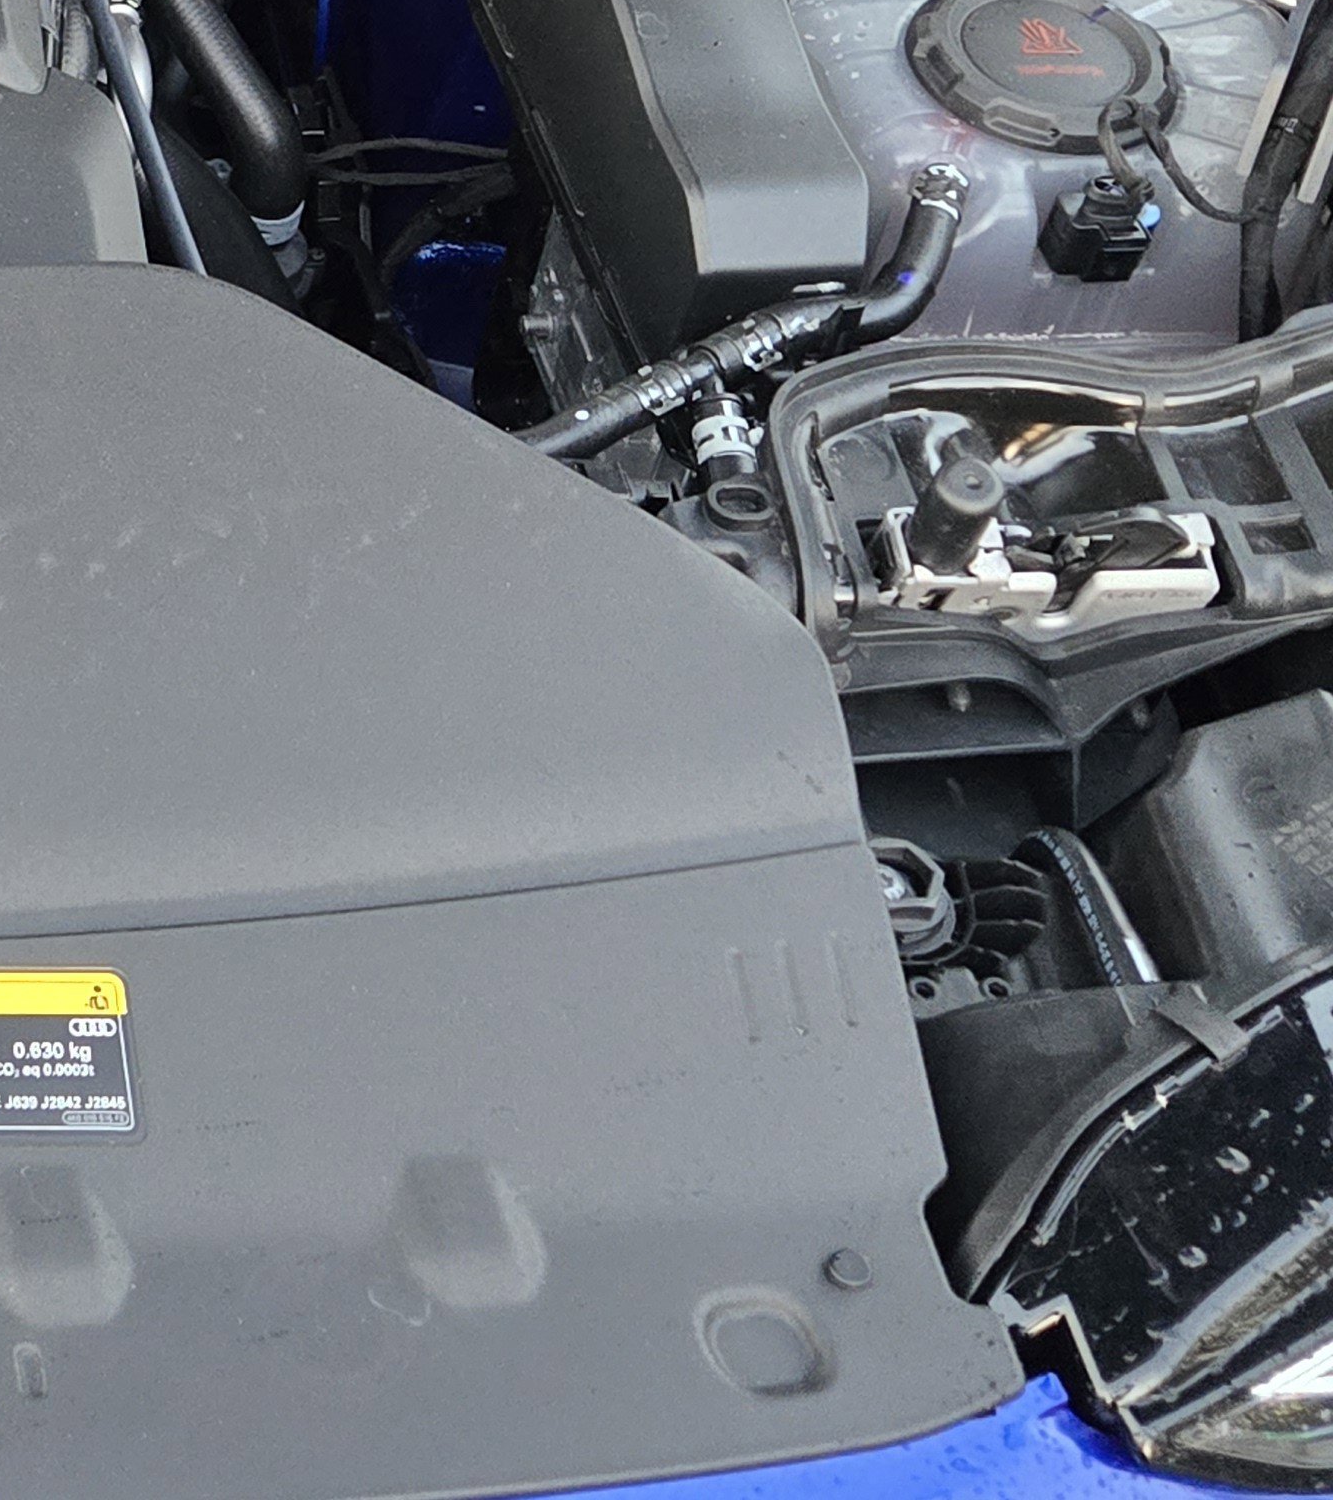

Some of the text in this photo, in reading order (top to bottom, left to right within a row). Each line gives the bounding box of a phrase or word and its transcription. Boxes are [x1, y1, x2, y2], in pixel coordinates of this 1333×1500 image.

[69, 1041, 92, 1062] kg
[22, 1064, 40, 1079] eq
[4, 1095, 38, 1110] J639
[40, 1095, 82, 1110] J2842
[85, 1095, 126, 1110] J2845
